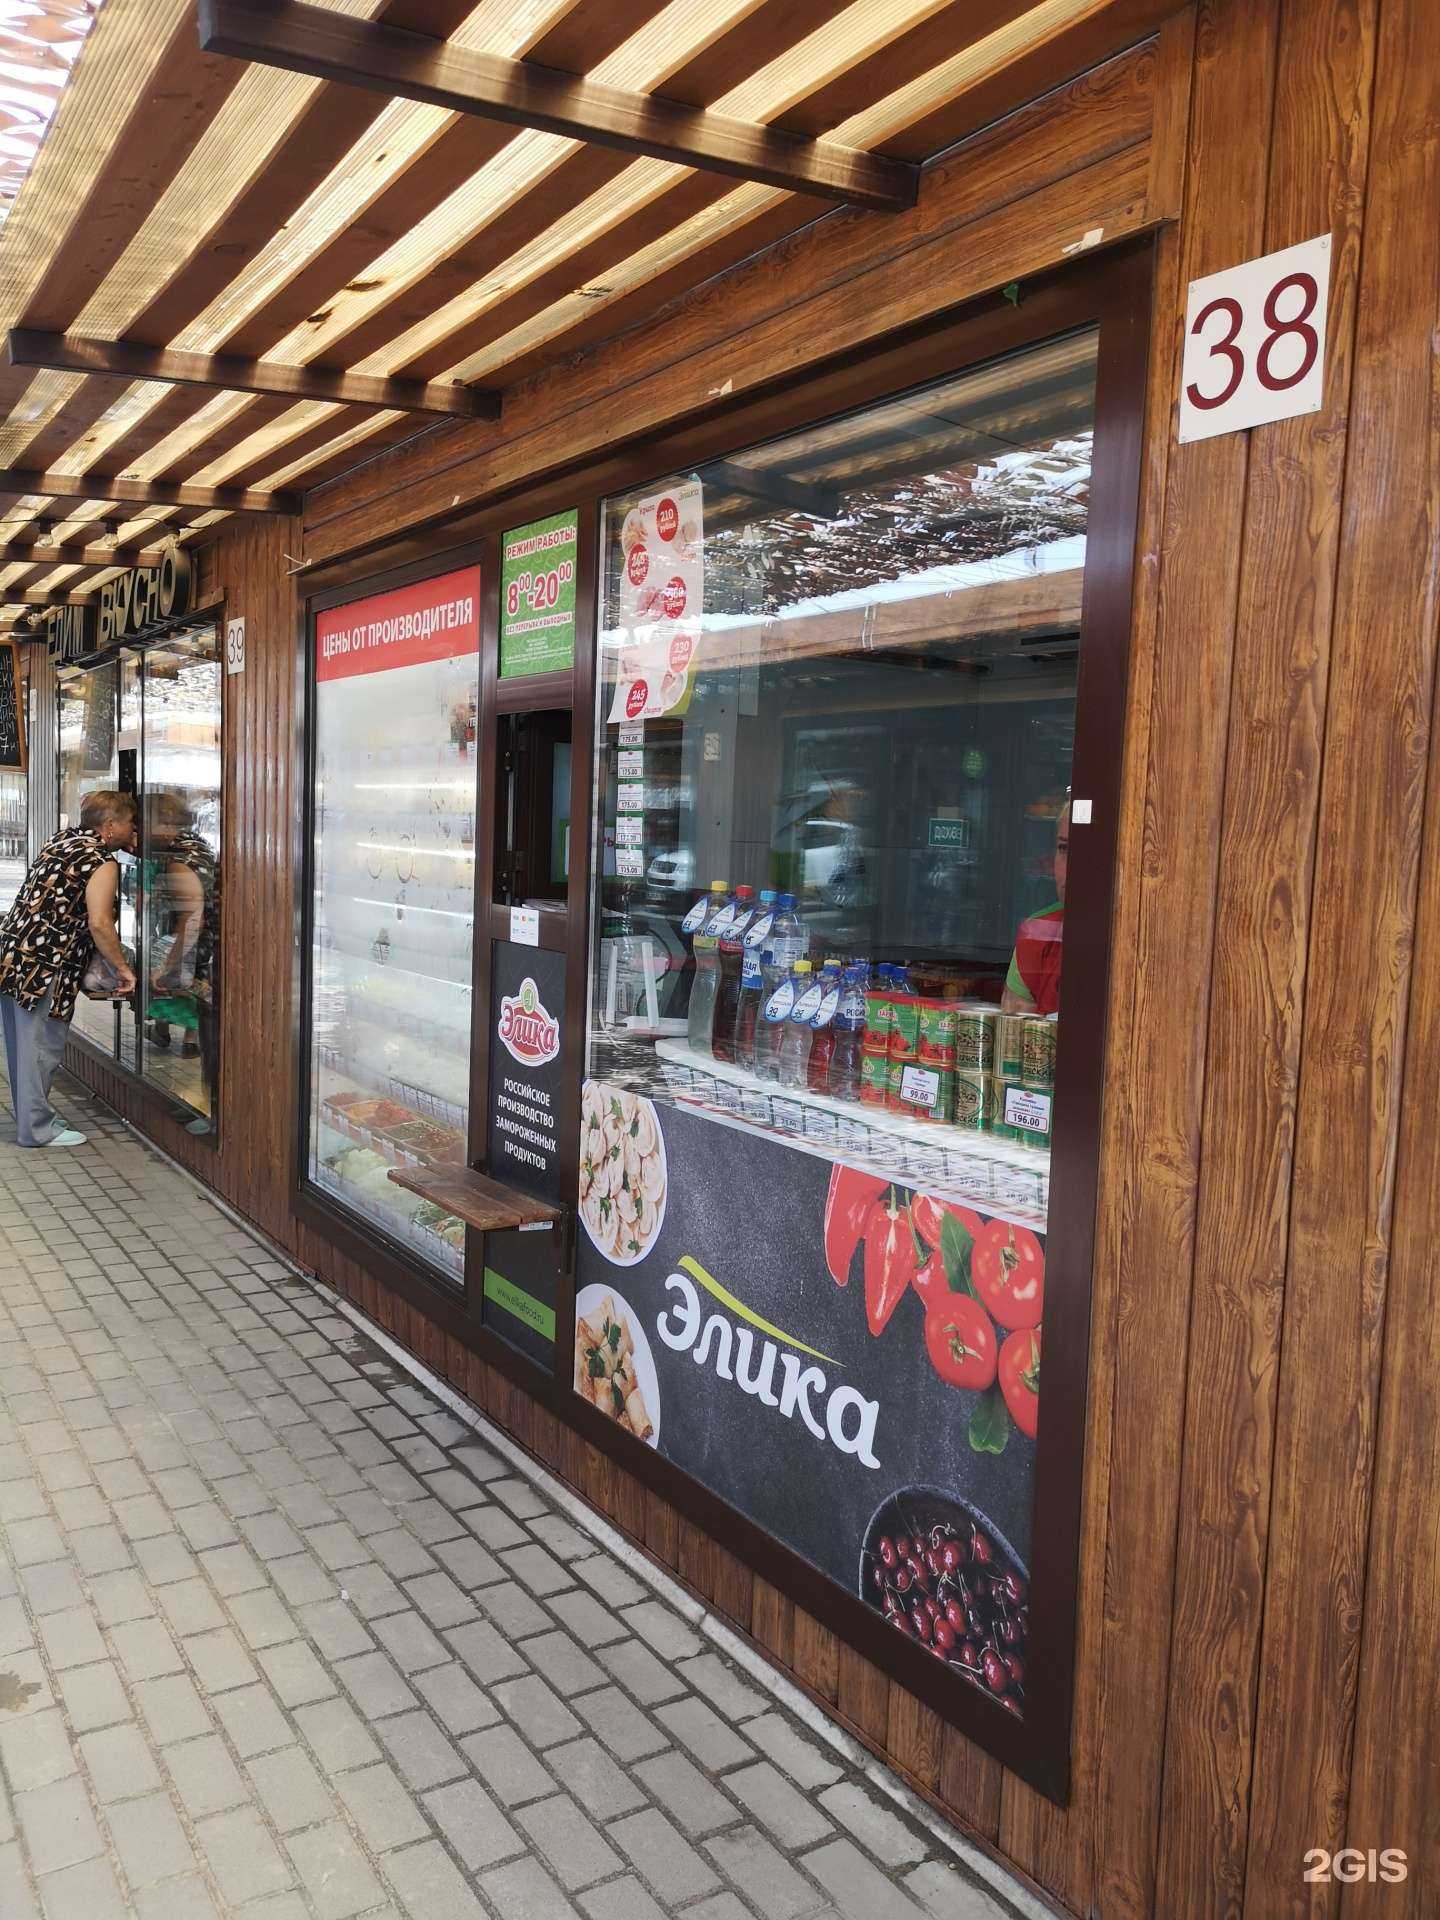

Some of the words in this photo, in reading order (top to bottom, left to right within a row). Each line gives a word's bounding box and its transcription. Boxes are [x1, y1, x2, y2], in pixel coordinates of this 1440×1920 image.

[1186, 273, 1319, 410] 38
[660, 509, 674, 522] 210
[506, 540, 536, 560] РЕЖИМ
[537, 525, 577, 551] РАБОТЫ:
[99, 547, 177, 645] ВКУСНО
[227, 626, 245, 664] 39
[322, 632, 350, 661] ЦЕНЫ
[352, 626, 367, 650] ОТ
[368, 597, 473, 647] ПРОИЗВОДИТЕЛЯ
[632, 689, 645, 701] 245
[501, 1003, 557, 1055] Элика
[504, 1078, 551, 1107] РОССИЙСКОЕ
[910, 1089, 929, 1101] 99.00
[498, 1094, 554, 1128] ПРОИЗВОДСТВО
[1013, 1113, 1040, 1127] 196.00
[496, 1115, 557, 1153] ЗАМОРОЖЕННЫХ
[504, 1140, 546, 1170] ПРОДУКТОВ
[657, 1273, 881, 1469] Элика
